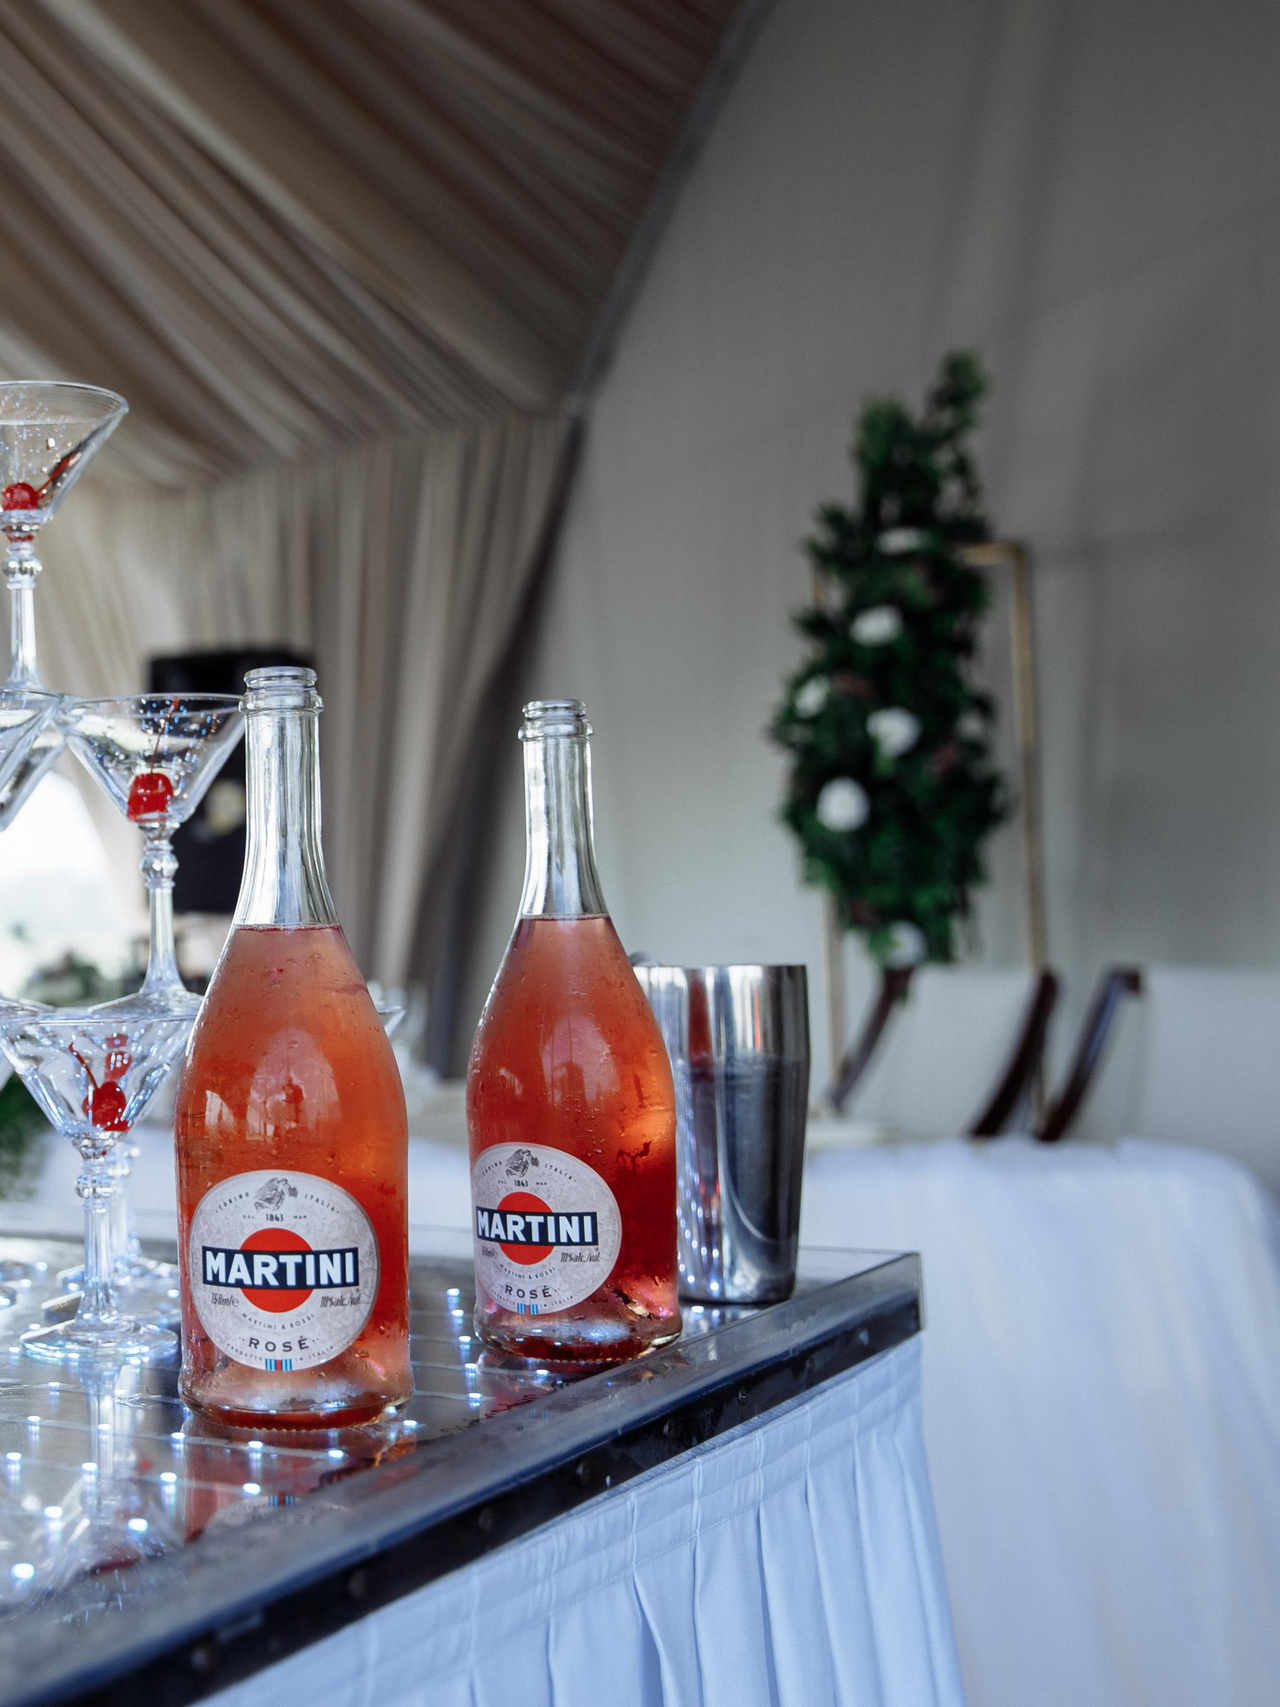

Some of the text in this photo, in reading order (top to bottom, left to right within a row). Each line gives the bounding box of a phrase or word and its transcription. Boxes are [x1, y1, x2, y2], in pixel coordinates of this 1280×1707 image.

[545, 1163, 573, 1182] ITALIA
[514, 1179, 529, 1187] 1863
[218, 1192, 336, 1213] TORINO ITALIA
[265, 1213, 284, 1222] 1863
[477, 1209, 594, 1244] MARTINI
[205, 1250, 354, 1287] MARTINI
[500, 1264, 525, 1279] MARTINI
[535, 1266, 556, 1279] ROSSI
[504, 1285, 552, 1300] ROSÉ
[242, 1313, 277, 1330] MARTINI
[290, 1313, 315, 1328] ROSSI
[248, 1335, 309, 1352] ROSÉ
[308, 1345, 334, 1361] ITALIA
